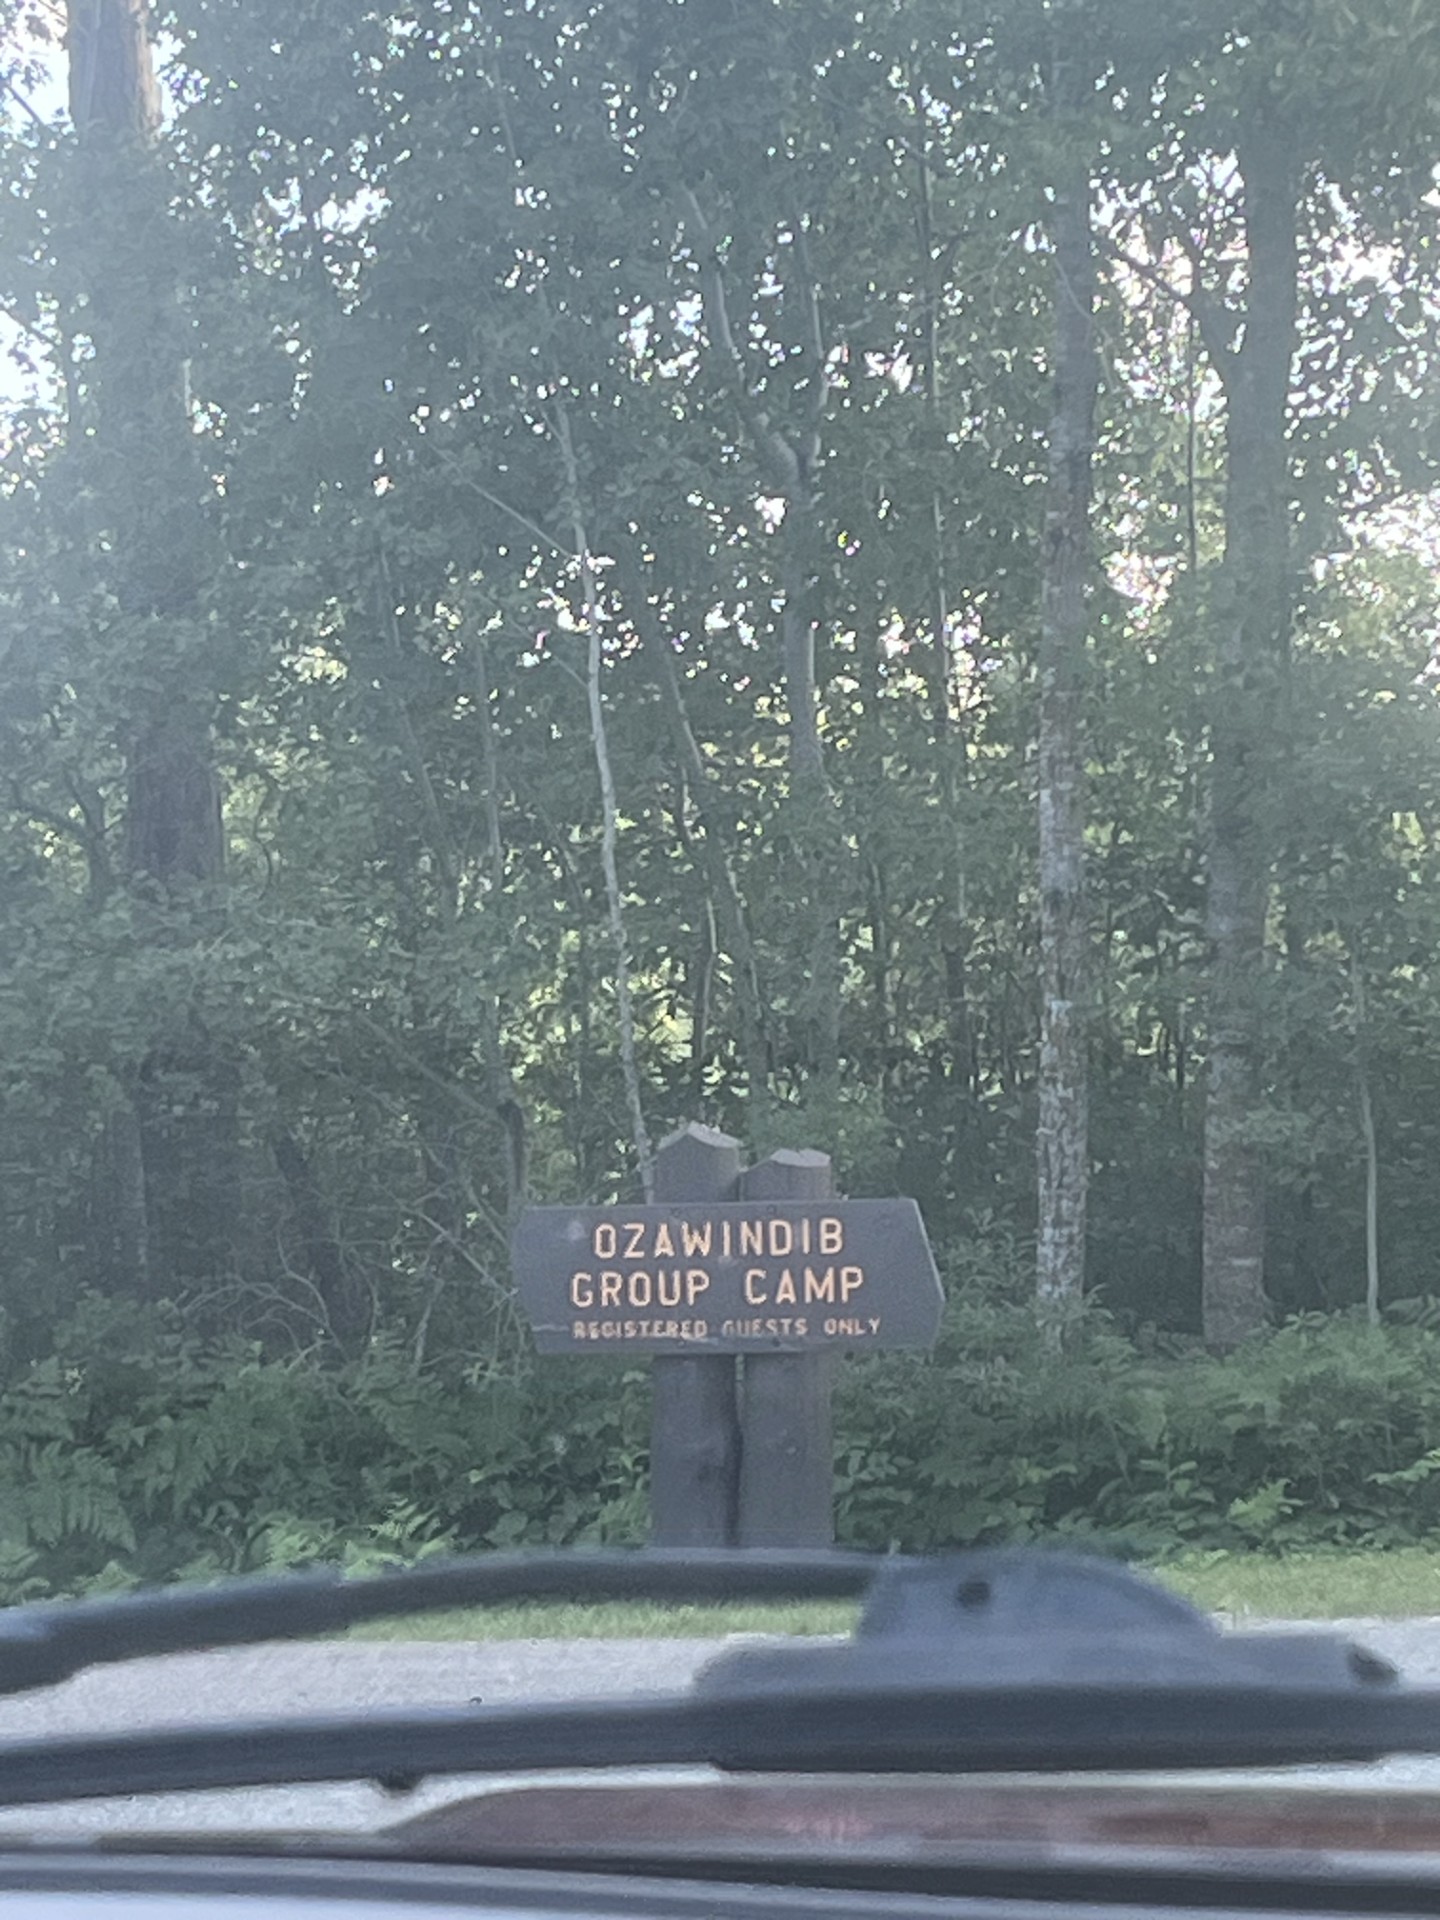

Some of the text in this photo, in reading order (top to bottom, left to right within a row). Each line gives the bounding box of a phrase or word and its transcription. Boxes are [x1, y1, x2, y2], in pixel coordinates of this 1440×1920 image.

[593, 1217, 845, 1259] OZAWINDIB
[571, 1266, 865, 1308] GROUP CAMP
[573, 1317, 881, 1339] REGISTERED GUESTS ONLY
